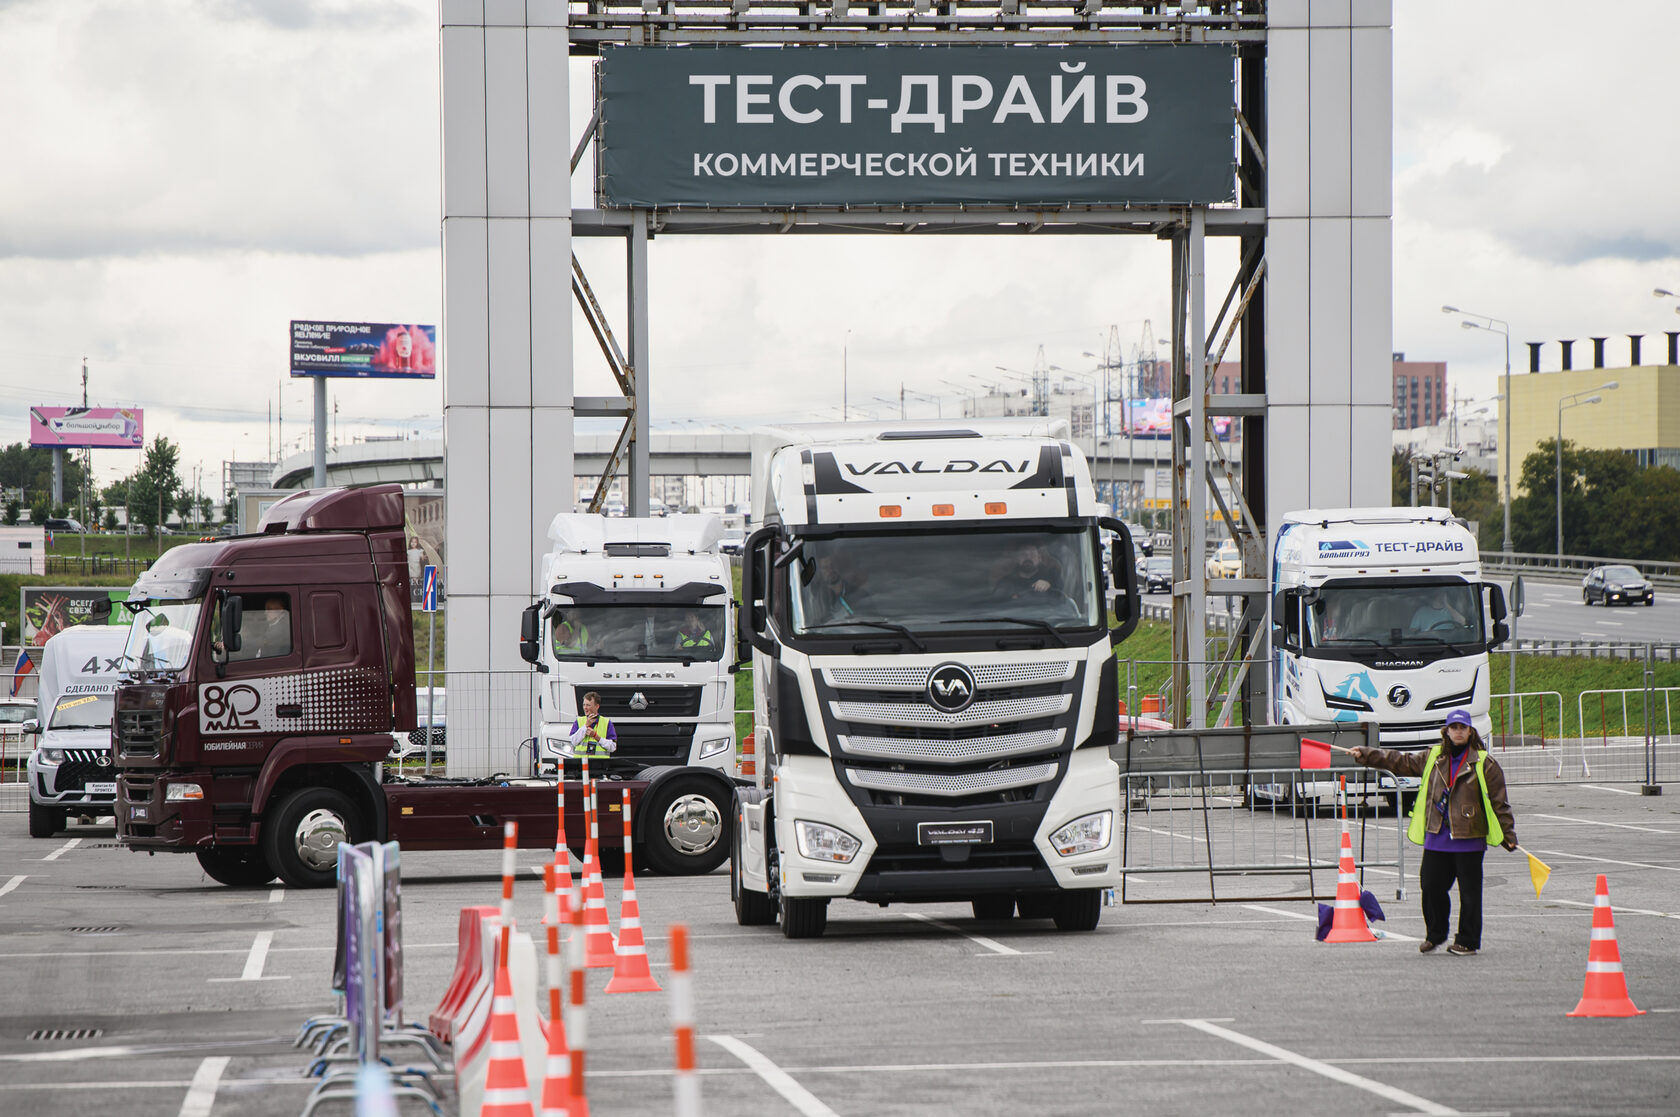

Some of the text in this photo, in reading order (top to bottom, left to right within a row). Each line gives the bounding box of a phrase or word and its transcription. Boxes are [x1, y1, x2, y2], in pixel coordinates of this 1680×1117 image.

[689, 61, 1150, 134] ТЕСТ-ДРАЙВ
[693, 146, 1145, 177] КОММЕРЧЕСКОЙ ТЕХНИКИ
[325, 324, 371, 334] ПРИРОДНОЕ
[294, 331, 331, 340] ЯВЛЕНИЕ
[294, 353, 340, 362] ВКУСВИЛЛ
[66, 421, 97, 429] большой
[844, 459, 1030, 476] VALDAI
[1375, 540, 1464, 553] ТЕСТ-ДРАЙВ
[1318, 551, 1370, 559] БОЛЬШЕГРУЗ
[602, 670, 676, 679] SITRAK
[65, 684, 109, 694] СДЕЛАНО
[203, 684, 261, 719] 80
[204, 741, 247, 751] ЮБИЛЕЙНАЯ
